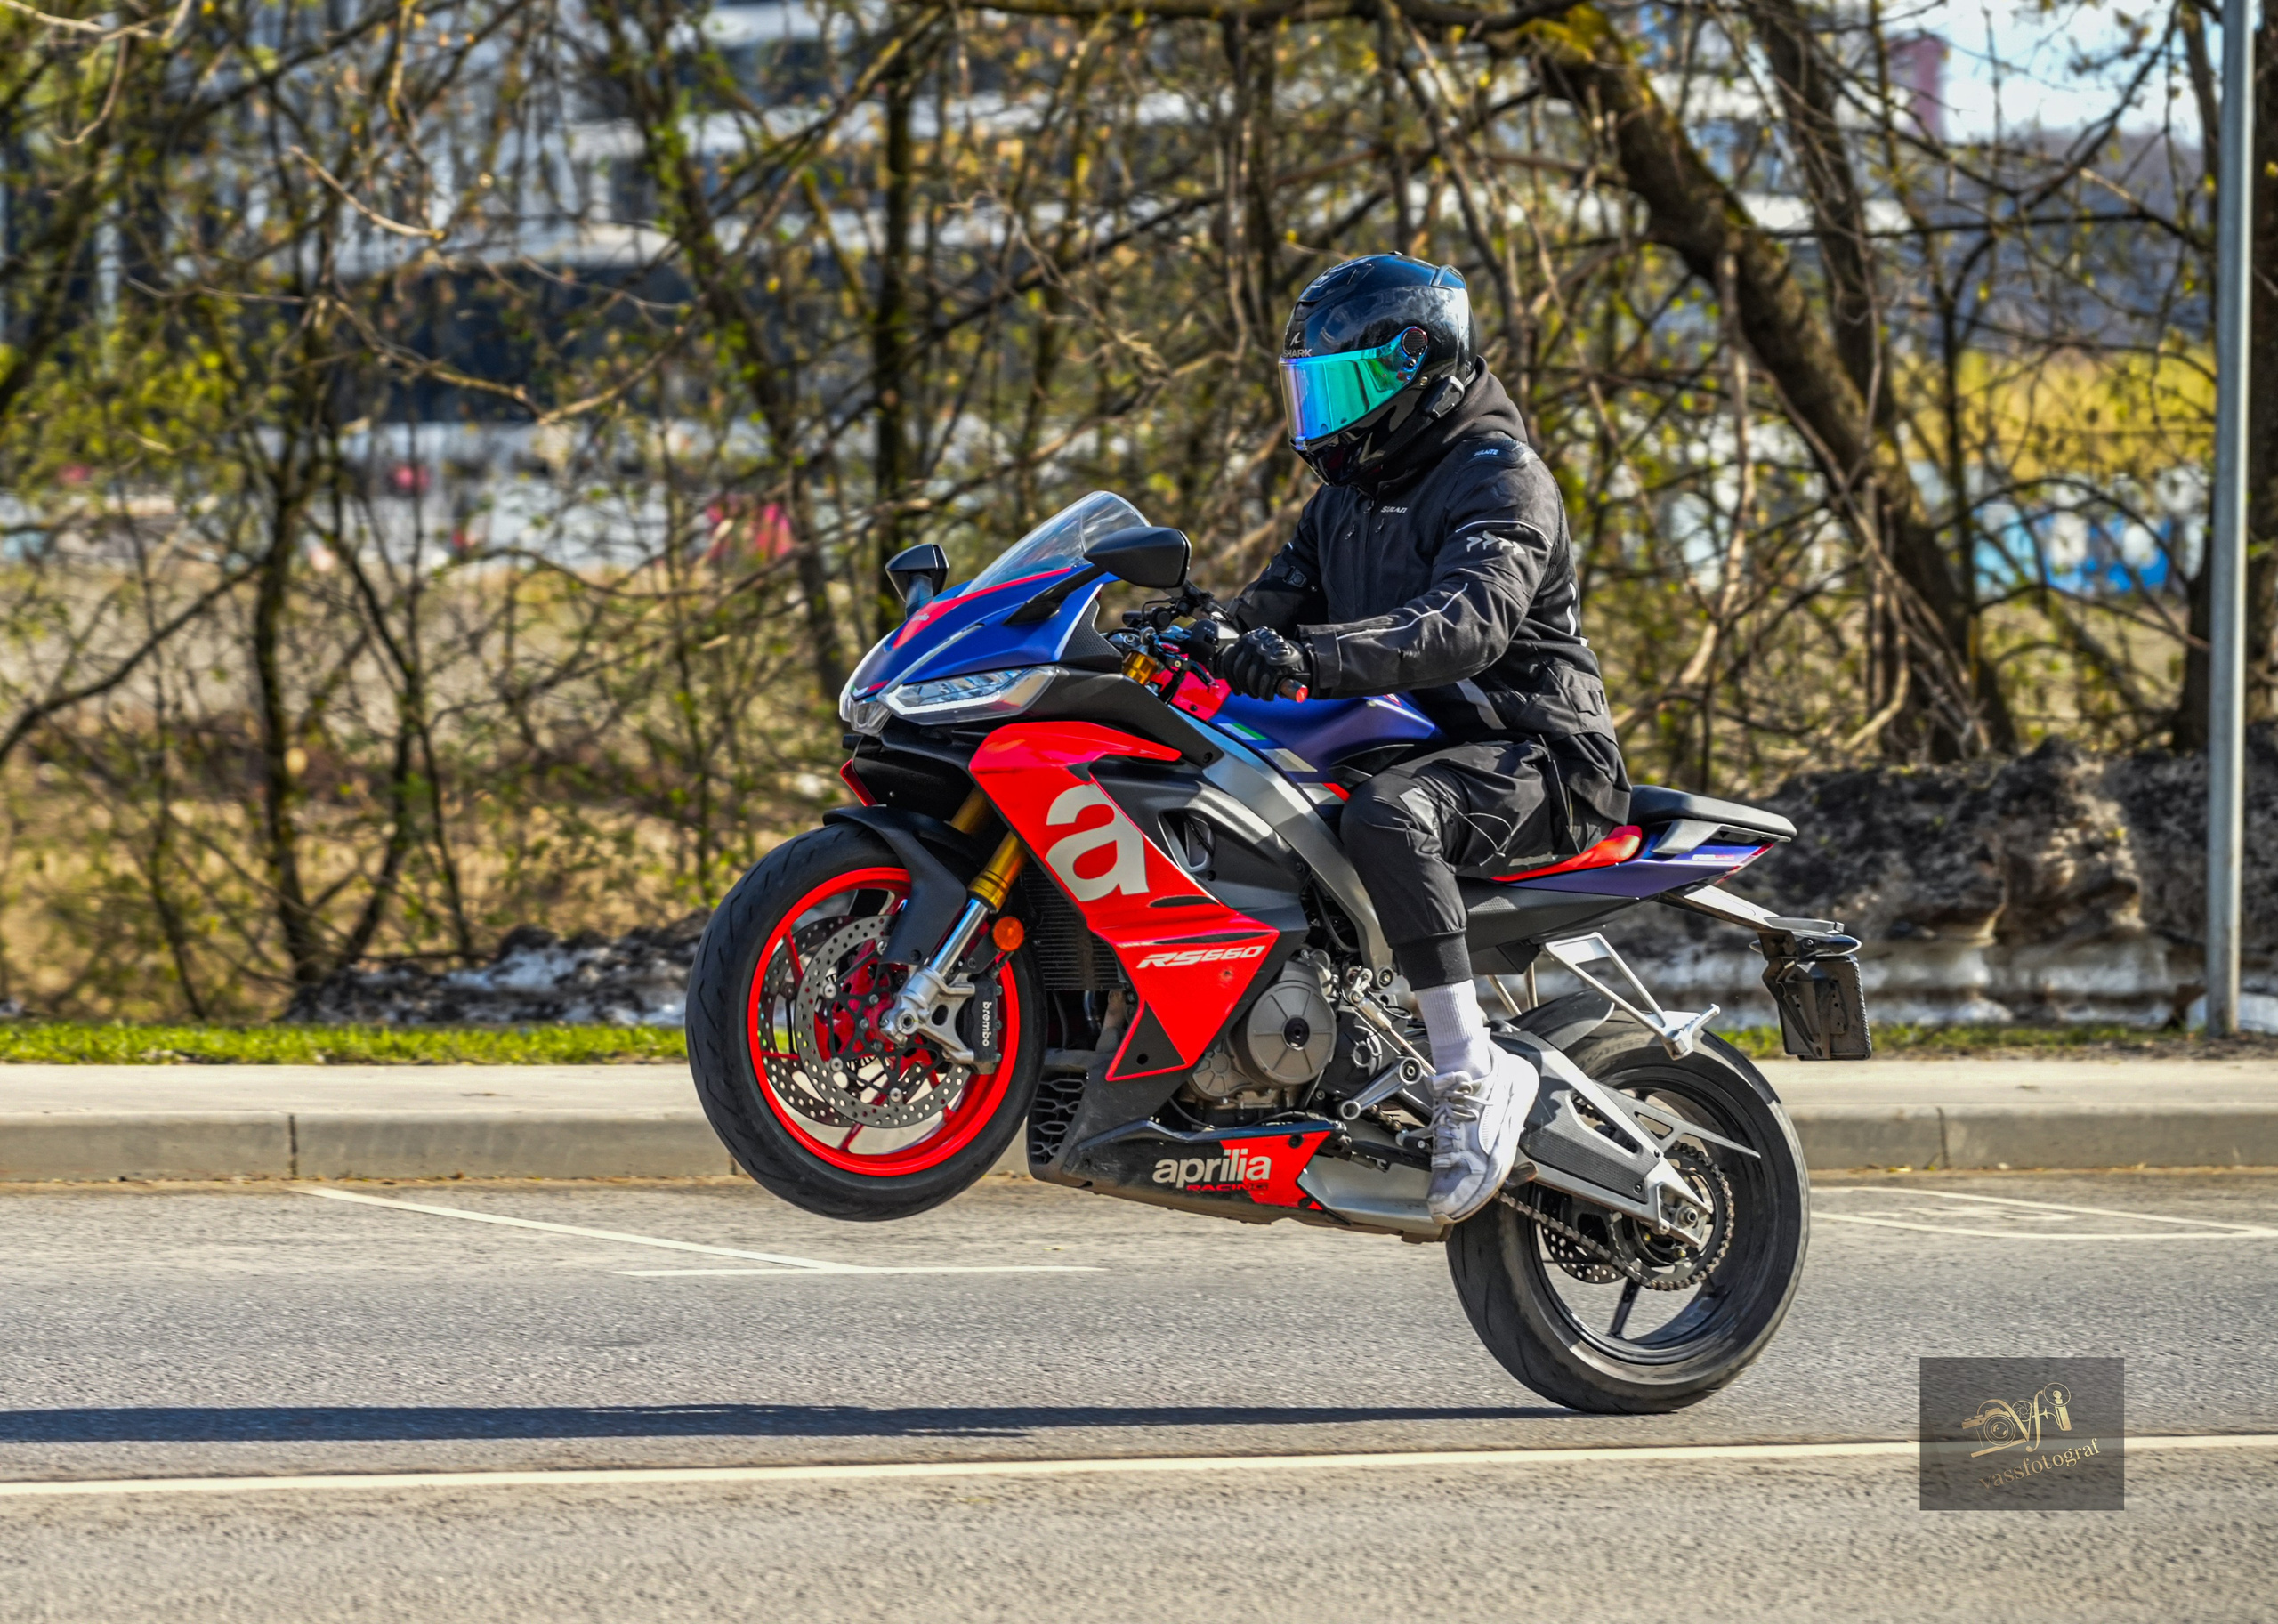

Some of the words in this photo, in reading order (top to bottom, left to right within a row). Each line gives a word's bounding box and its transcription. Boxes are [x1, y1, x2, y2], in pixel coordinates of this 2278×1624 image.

[1283, 348, 1313, 358] SHARK
[1045, 782, 1150, 902] a
[1135, 945, 1265, 969] RS660
[981, 1001, 992, 1047] brembo
[1152, 1148, 1272, 1189] aprilia
[1186, 1183, 1269, 1192] RACING
